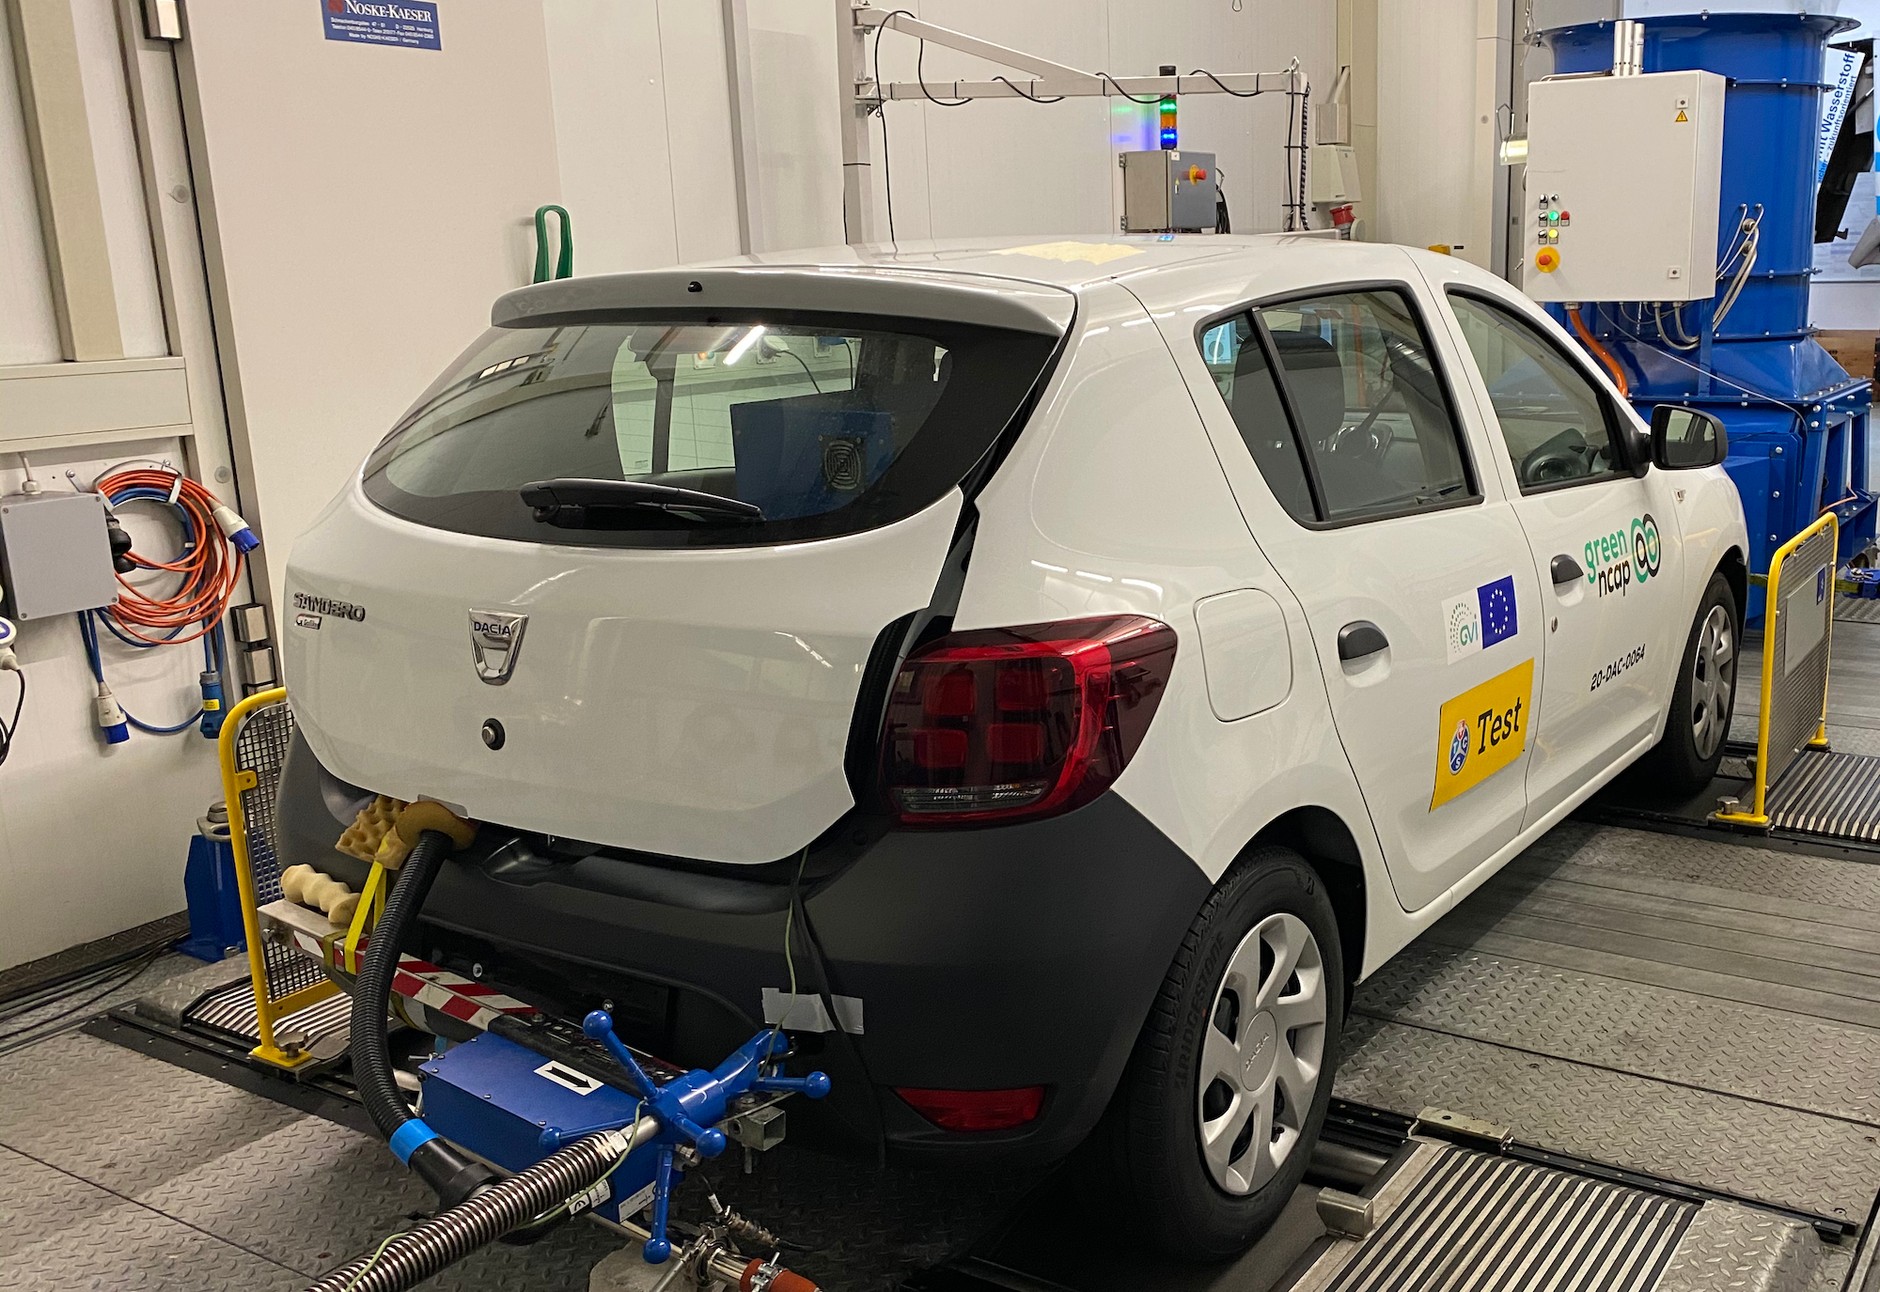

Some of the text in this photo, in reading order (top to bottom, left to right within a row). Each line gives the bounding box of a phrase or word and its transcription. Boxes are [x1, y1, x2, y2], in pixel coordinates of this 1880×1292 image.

[346, 0, 432, 22] NOSKE-KAESER
[1821, 53, 1856, 132] Wasserstoff
[1584, 529, 1628, 584] green
[1598, 560, 1631, 598] ncap
[293, 592, 366, 622] SANDERO
[474, 621, 511, 636] DACIA
[1590, 643, 1646, 692] 20-DAC-0064
[1477, 696, 1522, 755] Test
